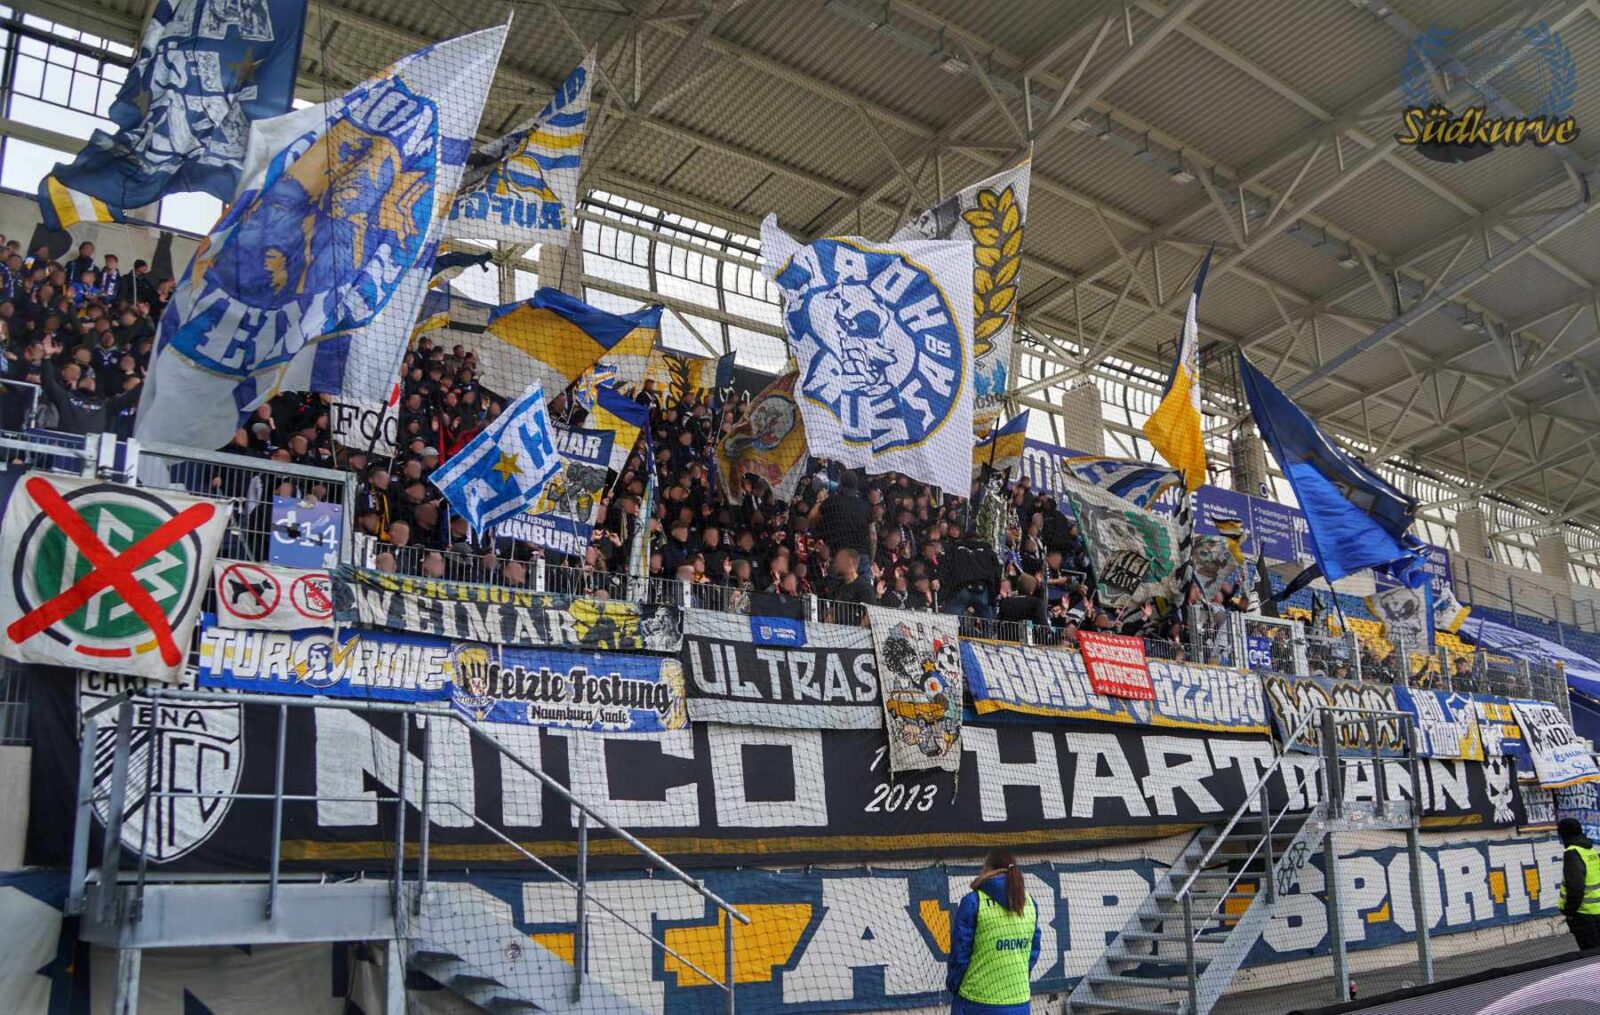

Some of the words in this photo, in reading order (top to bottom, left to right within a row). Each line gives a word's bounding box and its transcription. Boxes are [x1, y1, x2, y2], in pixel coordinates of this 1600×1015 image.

[348, 582, 582, 646] WEIMAR
[487, 663, 567, 703] Letzte
[568, 667, 672, 714] Festung
[687, 640, 879, 702] ULTRAS
[315, 706, 829, 828] NICO
[864, 782, 938, 813] 2013
